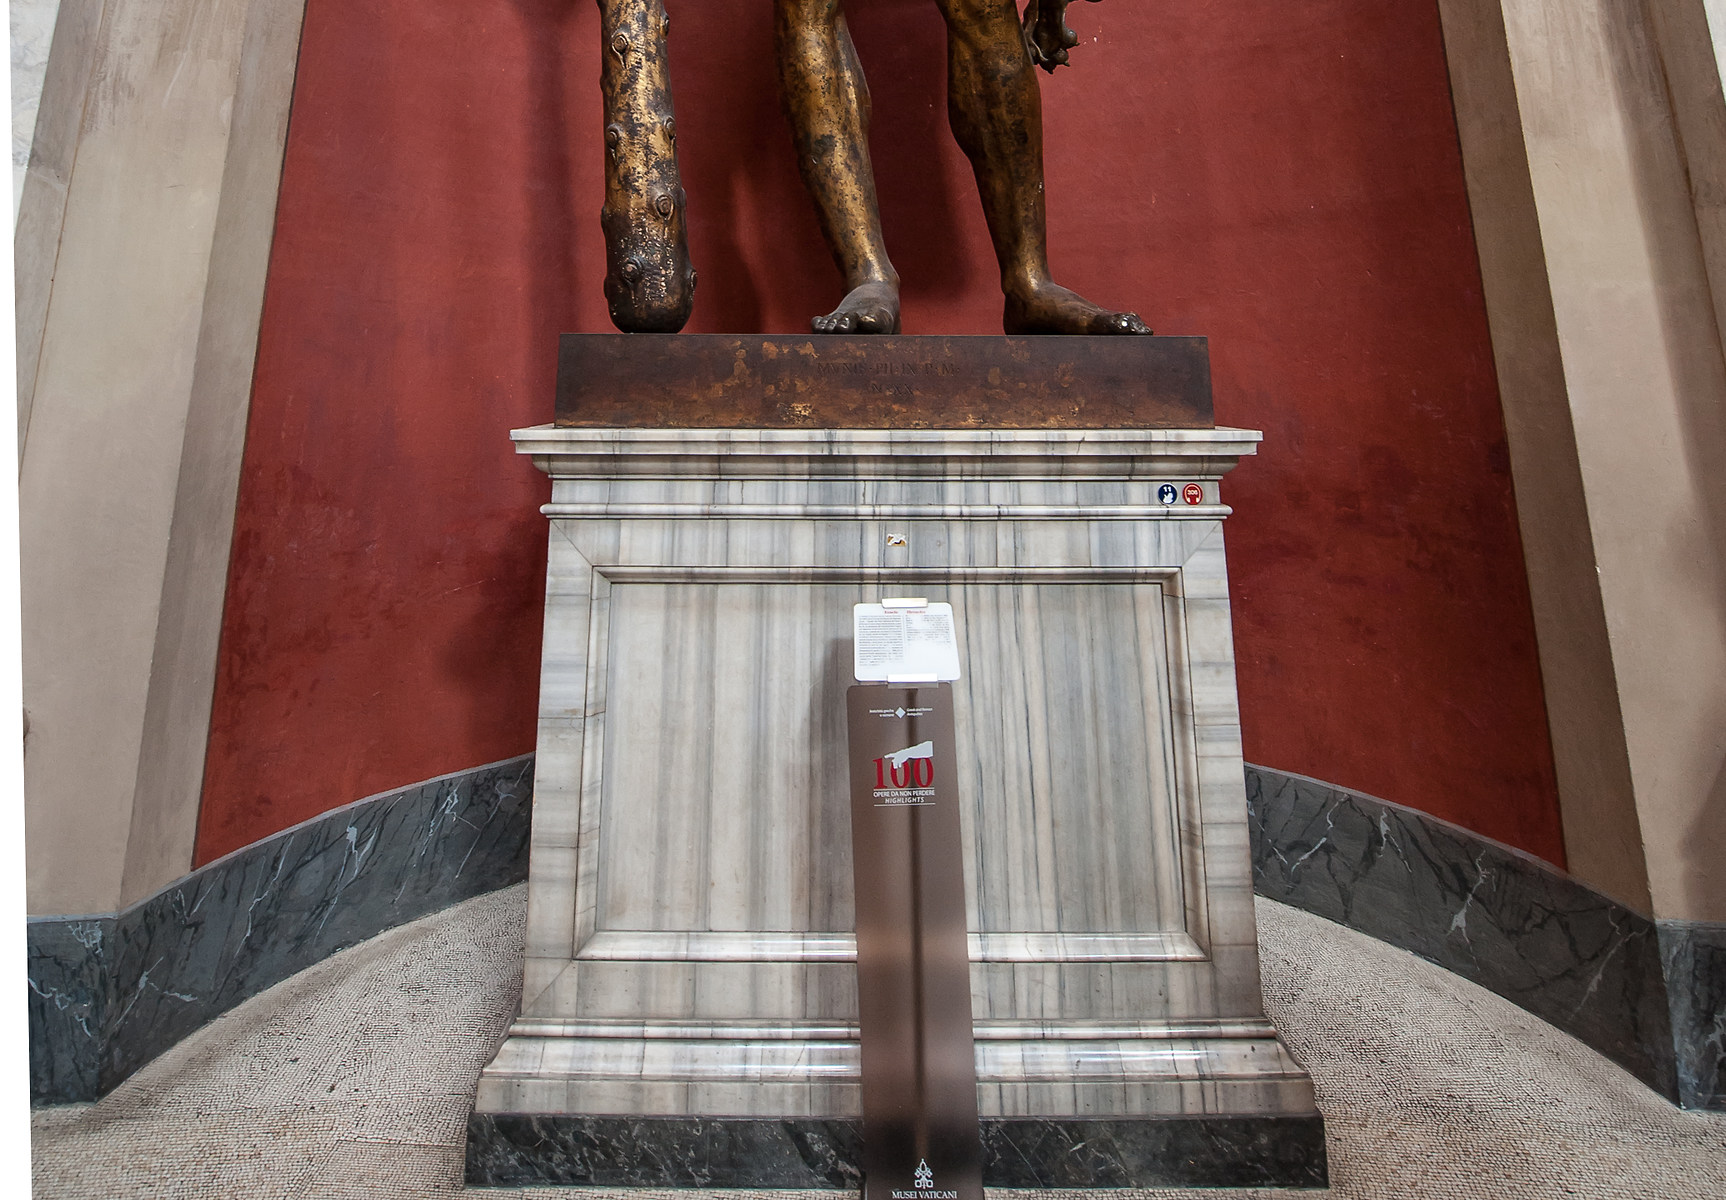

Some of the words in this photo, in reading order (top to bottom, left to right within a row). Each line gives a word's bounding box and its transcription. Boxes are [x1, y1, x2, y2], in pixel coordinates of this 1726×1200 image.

[872, 757, 934, 789] 100
[884, 796, 925, 804] HIGHLIGHTS
[891, 1190, 918, 1199] MUSEI
[918, 1190, 958, 1199] VATICANI
